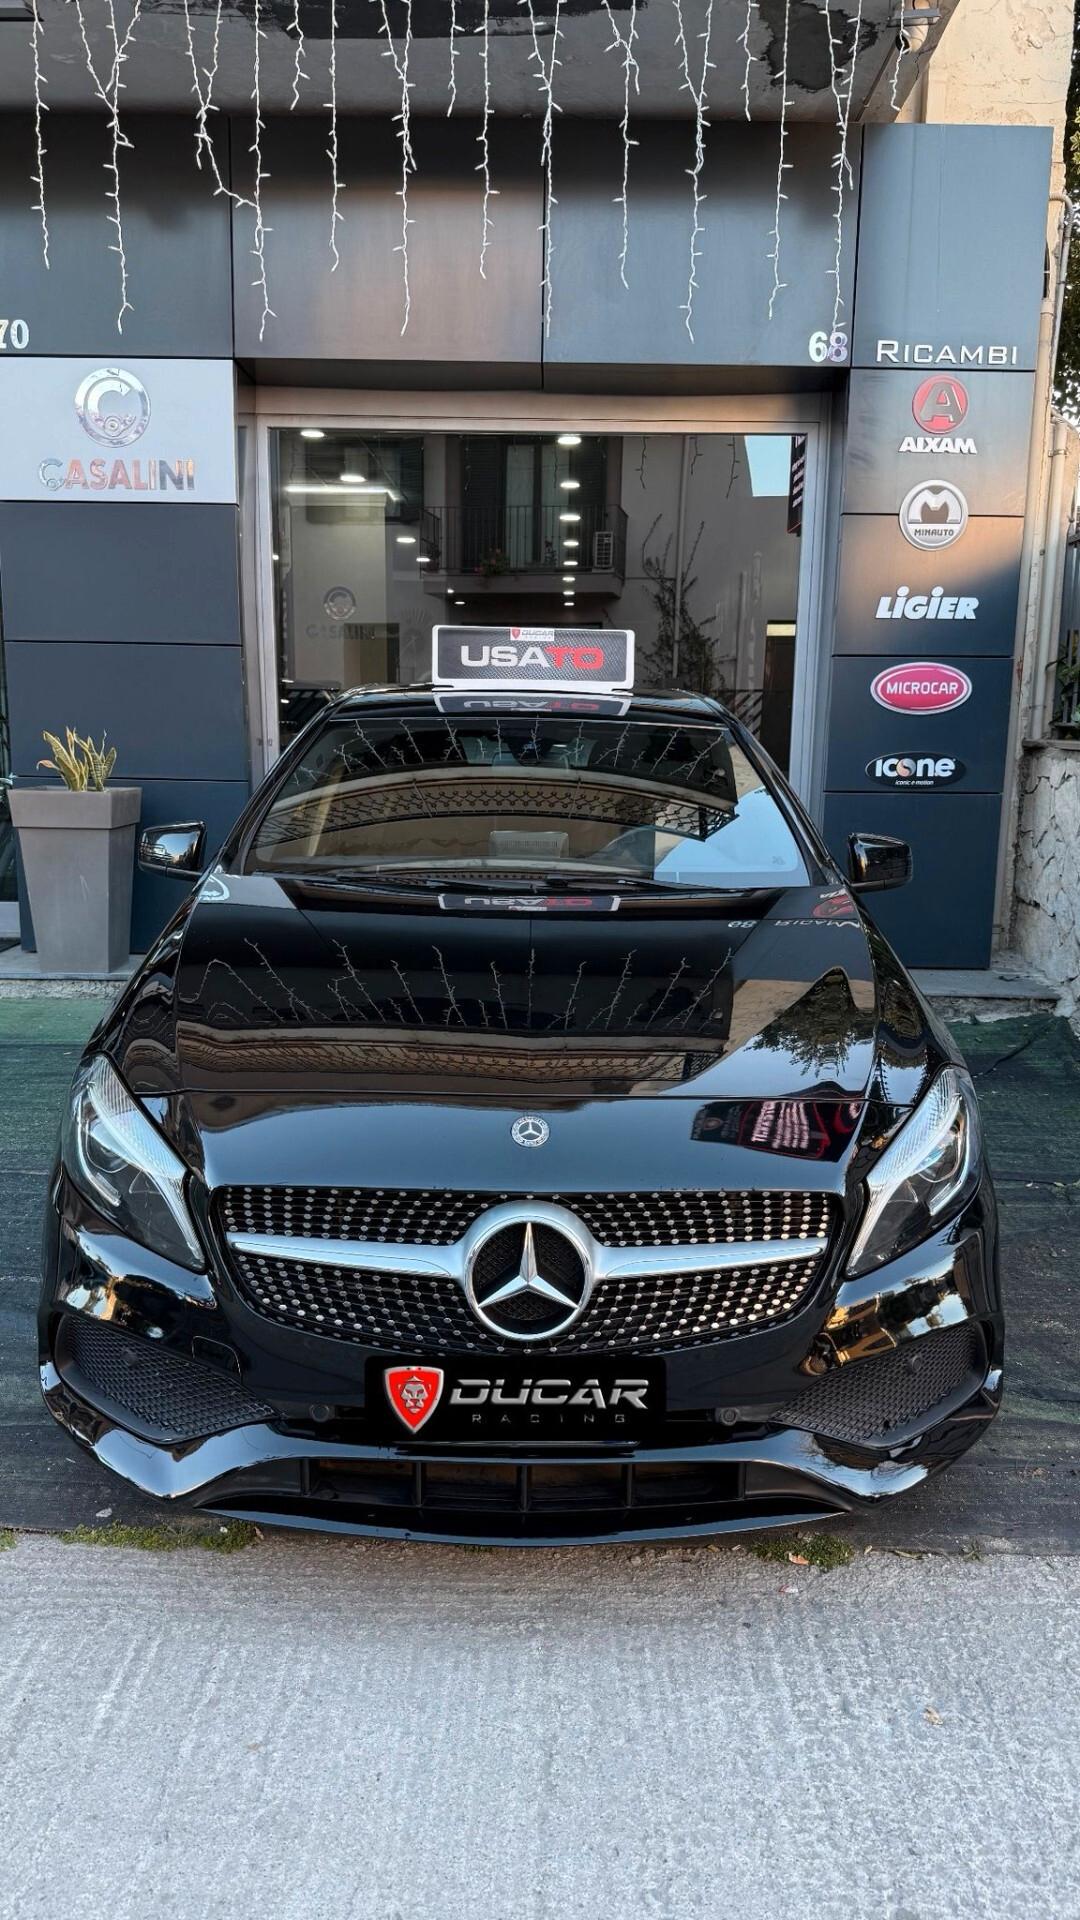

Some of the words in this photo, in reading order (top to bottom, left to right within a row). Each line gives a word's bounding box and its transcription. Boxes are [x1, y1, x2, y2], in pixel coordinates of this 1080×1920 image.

[808, 331, 849, 363] 68
[876, 340, 1018, 365] RICAMBI
[899, 436, 977, 454] AIXAM
[38, 458, 196, 491] CASALINI
[914, 528, 955, 537] MINAUTO
[460, 645, 605, 669] USATO
[886, 681, 959, 695] MICROCAR
